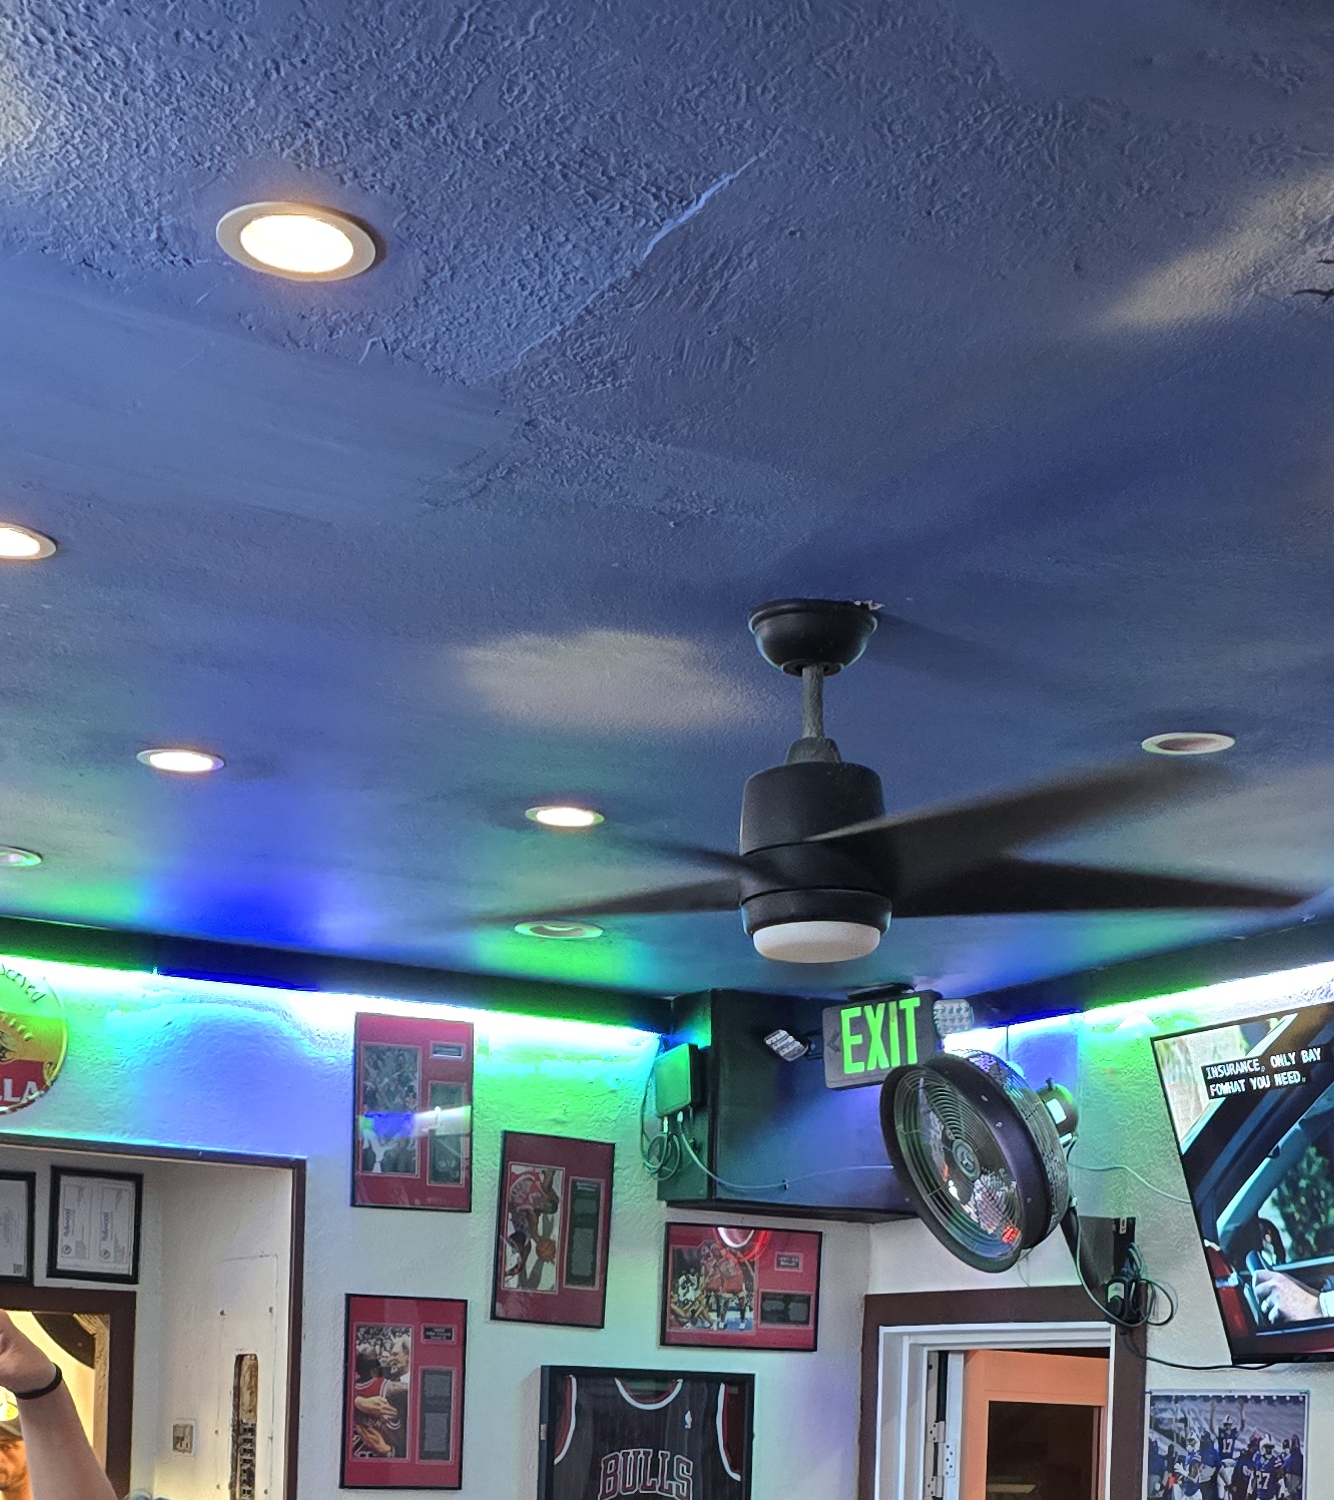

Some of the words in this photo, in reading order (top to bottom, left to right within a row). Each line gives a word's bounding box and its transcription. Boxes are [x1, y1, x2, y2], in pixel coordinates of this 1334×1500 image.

[841, 996, 920, 1074] EXIT
[1270, 1051, 1296, 1068] ONLY
[1301, 1047, 1322, 1064] BAY
[1249, 1075, 1271, 1090] YOU
[1222, 1439, 1233, 1453] 17
[1256, 1472, 1270, 1489] 27
